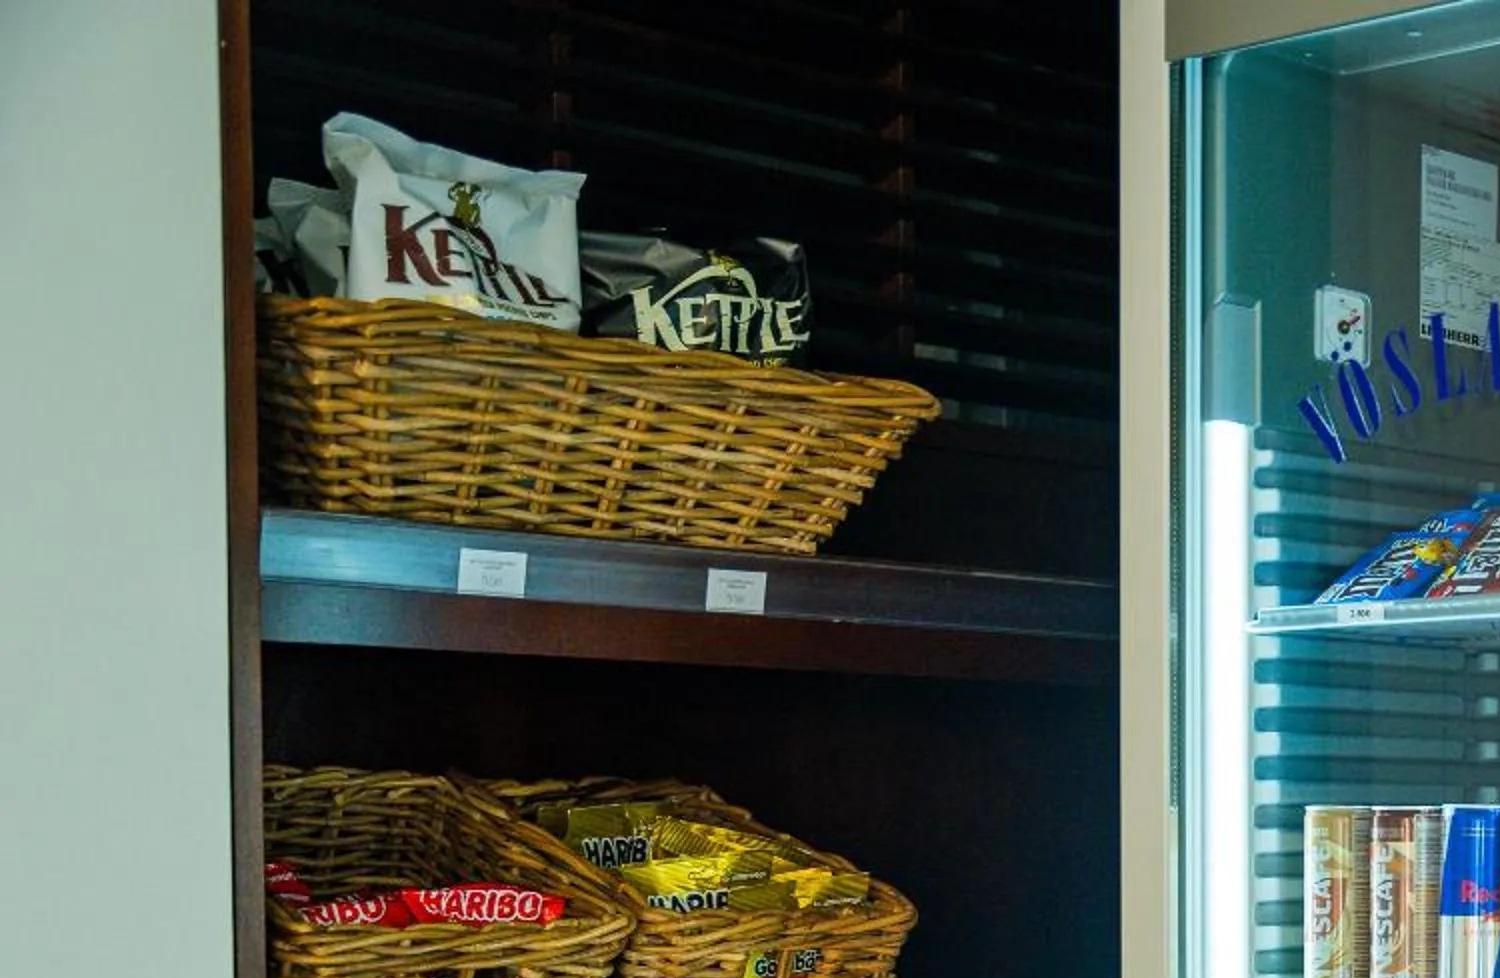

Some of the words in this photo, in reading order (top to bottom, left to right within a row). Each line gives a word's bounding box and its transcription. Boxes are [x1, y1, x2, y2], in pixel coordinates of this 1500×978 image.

[630, 265, 811, 353] KETTLE
[582, 837, 649, 868] HARIB
[420, 889, 544, 922] HARIBO
